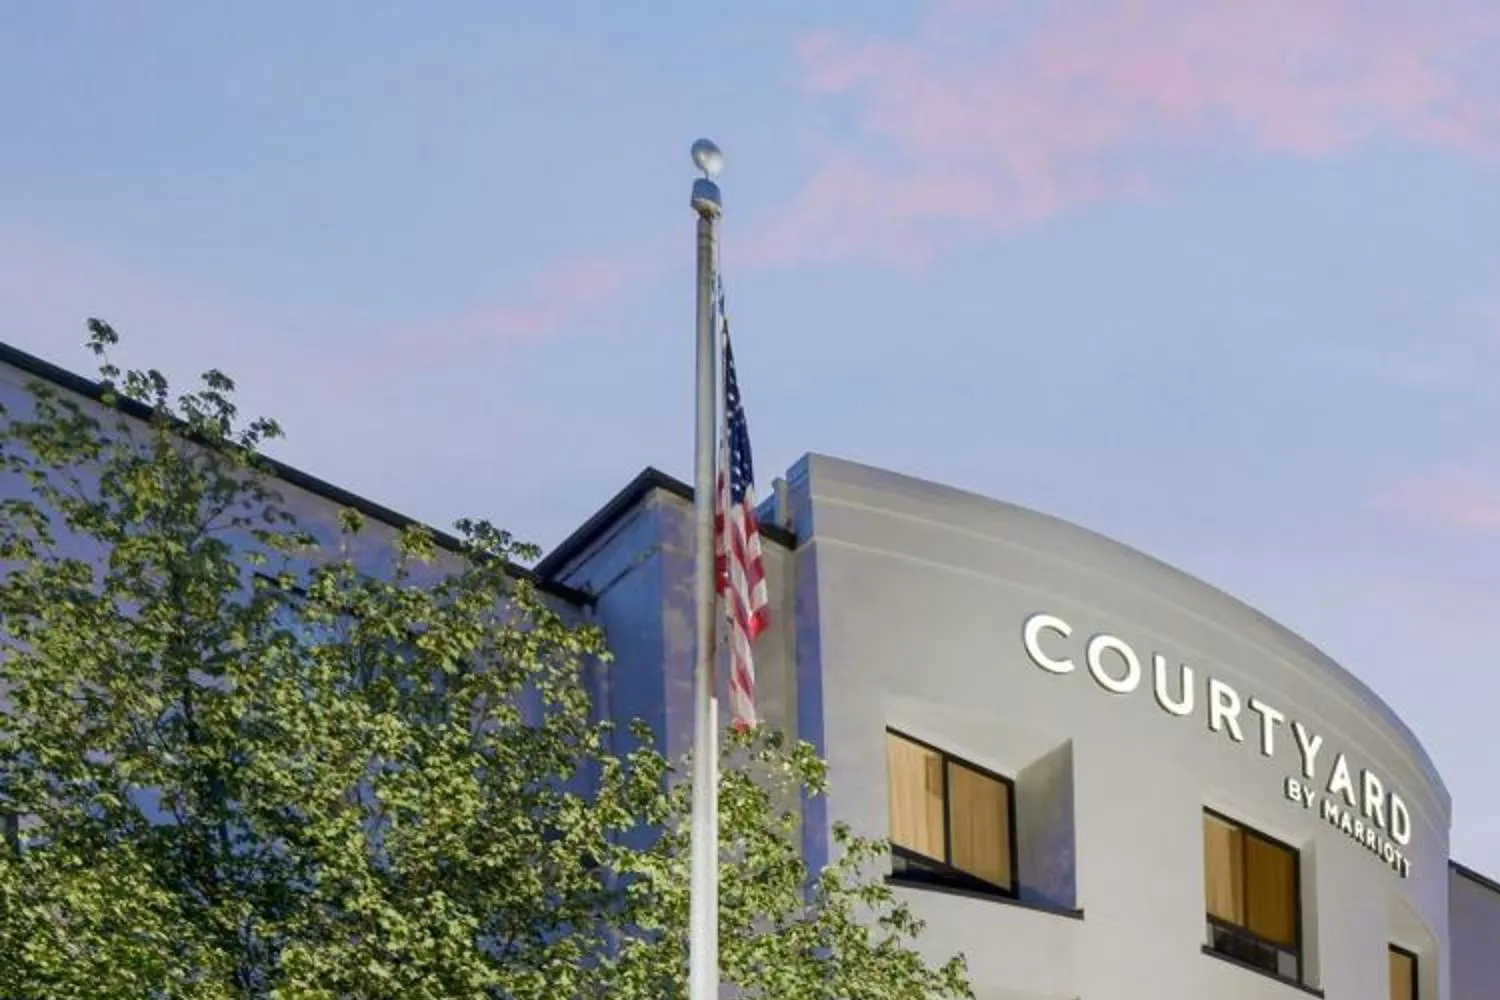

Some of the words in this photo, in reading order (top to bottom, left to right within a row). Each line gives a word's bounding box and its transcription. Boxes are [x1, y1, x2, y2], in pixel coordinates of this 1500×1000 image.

[1023, 613, 1411, 845] COURTYARD
[1285, 778, 1315, 808] BY
[1321, 799, 1411, 877] MARRIOTT
